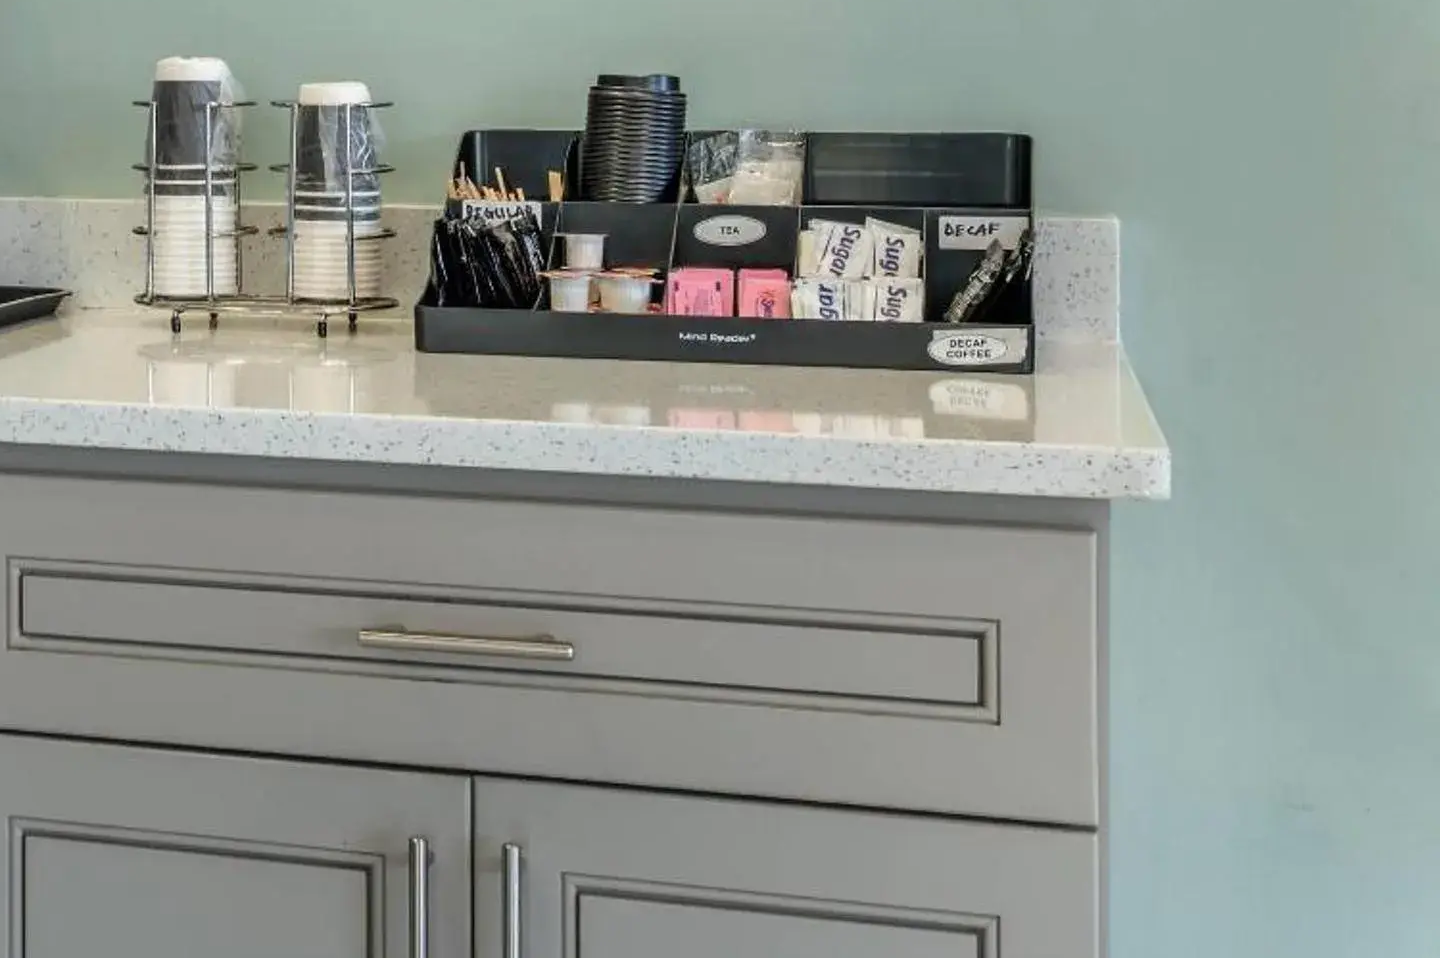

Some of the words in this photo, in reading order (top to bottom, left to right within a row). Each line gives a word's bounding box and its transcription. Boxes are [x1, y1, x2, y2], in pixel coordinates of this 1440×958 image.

[720, 225, 740, 235] TEA
[944, 222, 1000, 237] DECAF
[829, 225, 862, 277] Sugar
[879, 236, 905, 277] Sug
[819, 283, 840, 320] gar
[880, 285, 907, 321] Sug
[946, 350, 992, 359] COFFEE
[949, 339, 988, 348] DECAF
